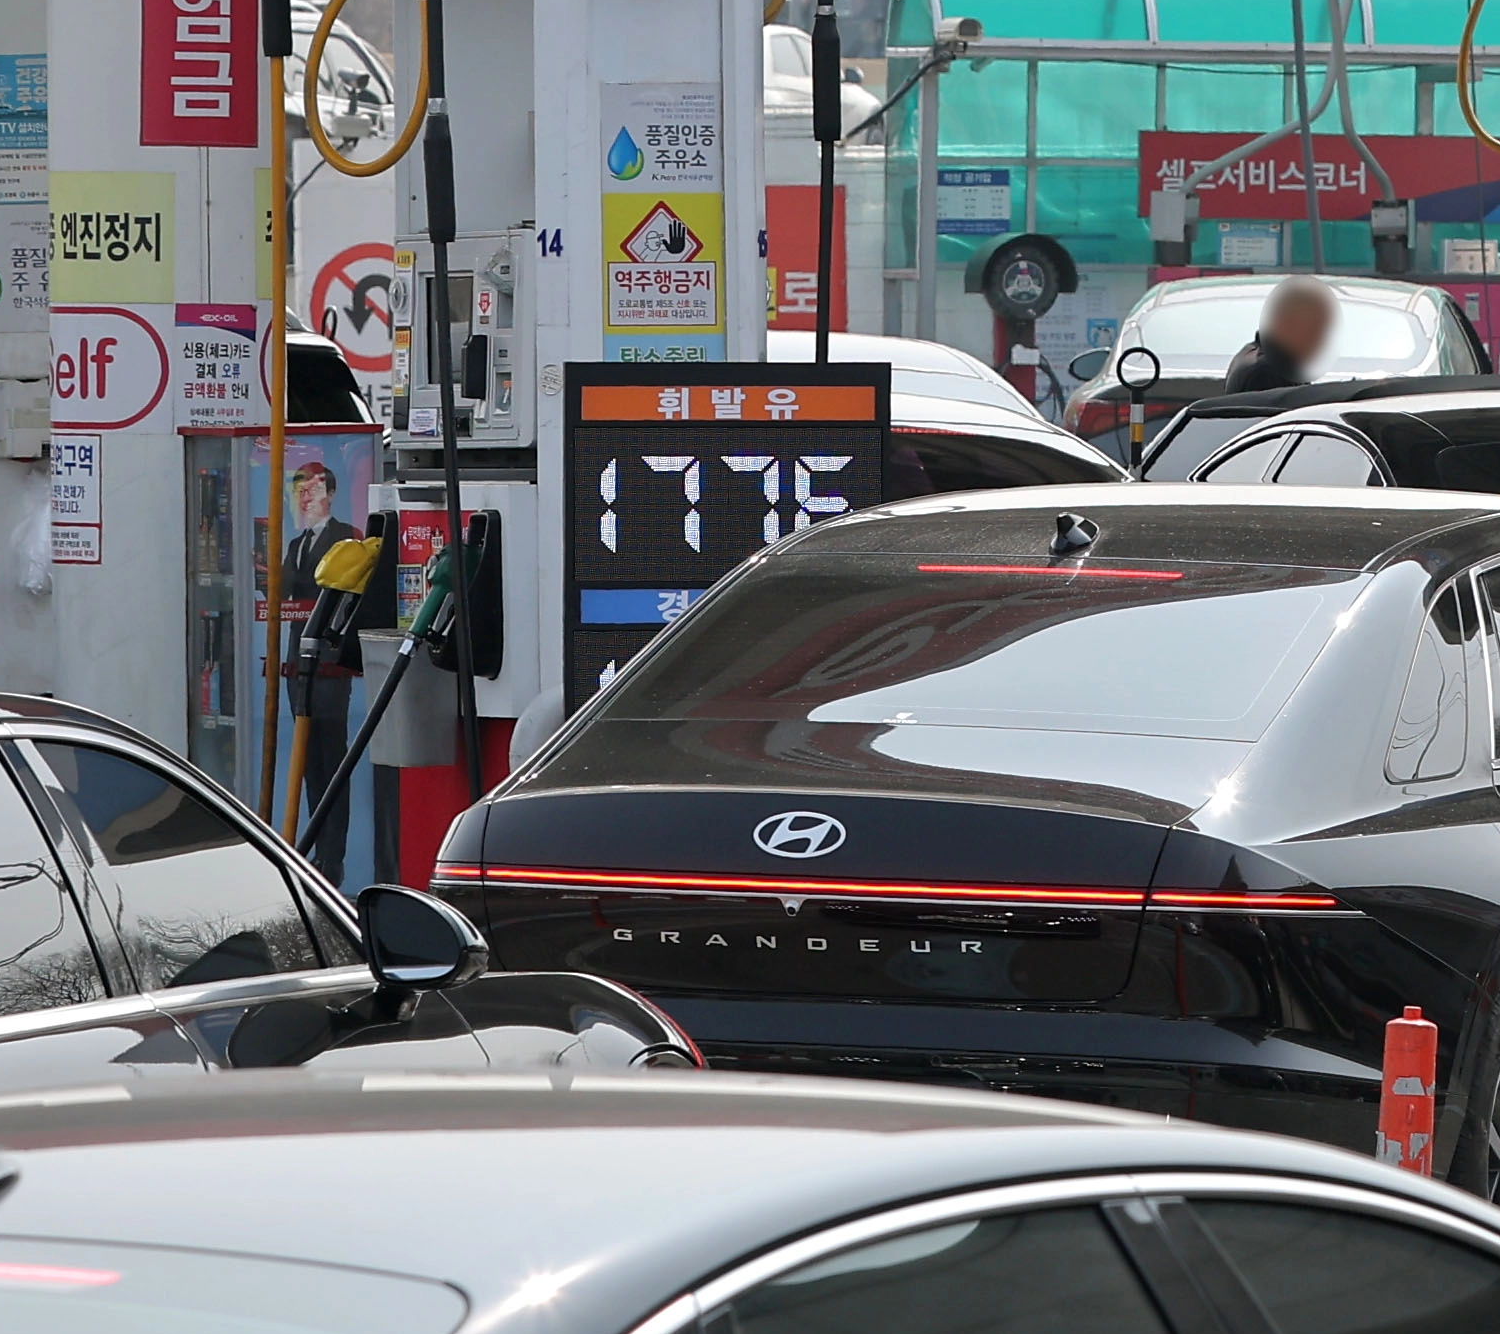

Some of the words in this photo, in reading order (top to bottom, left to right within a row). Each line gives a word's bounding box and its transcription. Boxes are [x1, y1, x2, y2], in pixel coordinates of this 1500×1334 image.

[644, 124, 716, 147] 품질인증
[654, 149, 708, 170] 주유소
[60, 211, 162, 262] 엔진정지
[536, 228, 564, 258] 14
[614, 269, 711, 295] 역주행금지
[183, 342, 251, 360] 신용(체크)카드
[49, 336, 118, 400] elf
[195, 362, 217, 379] 결제
[221, 362, 241, 379] 오류
[183, 381, 227, 399] 금액환불
[231, 382, 250, 400] 안내
[600, 453, 855, 555] 1776
[657, 588, 691, 623] 경
[612, 927, 983, 956] GRANDEUR
